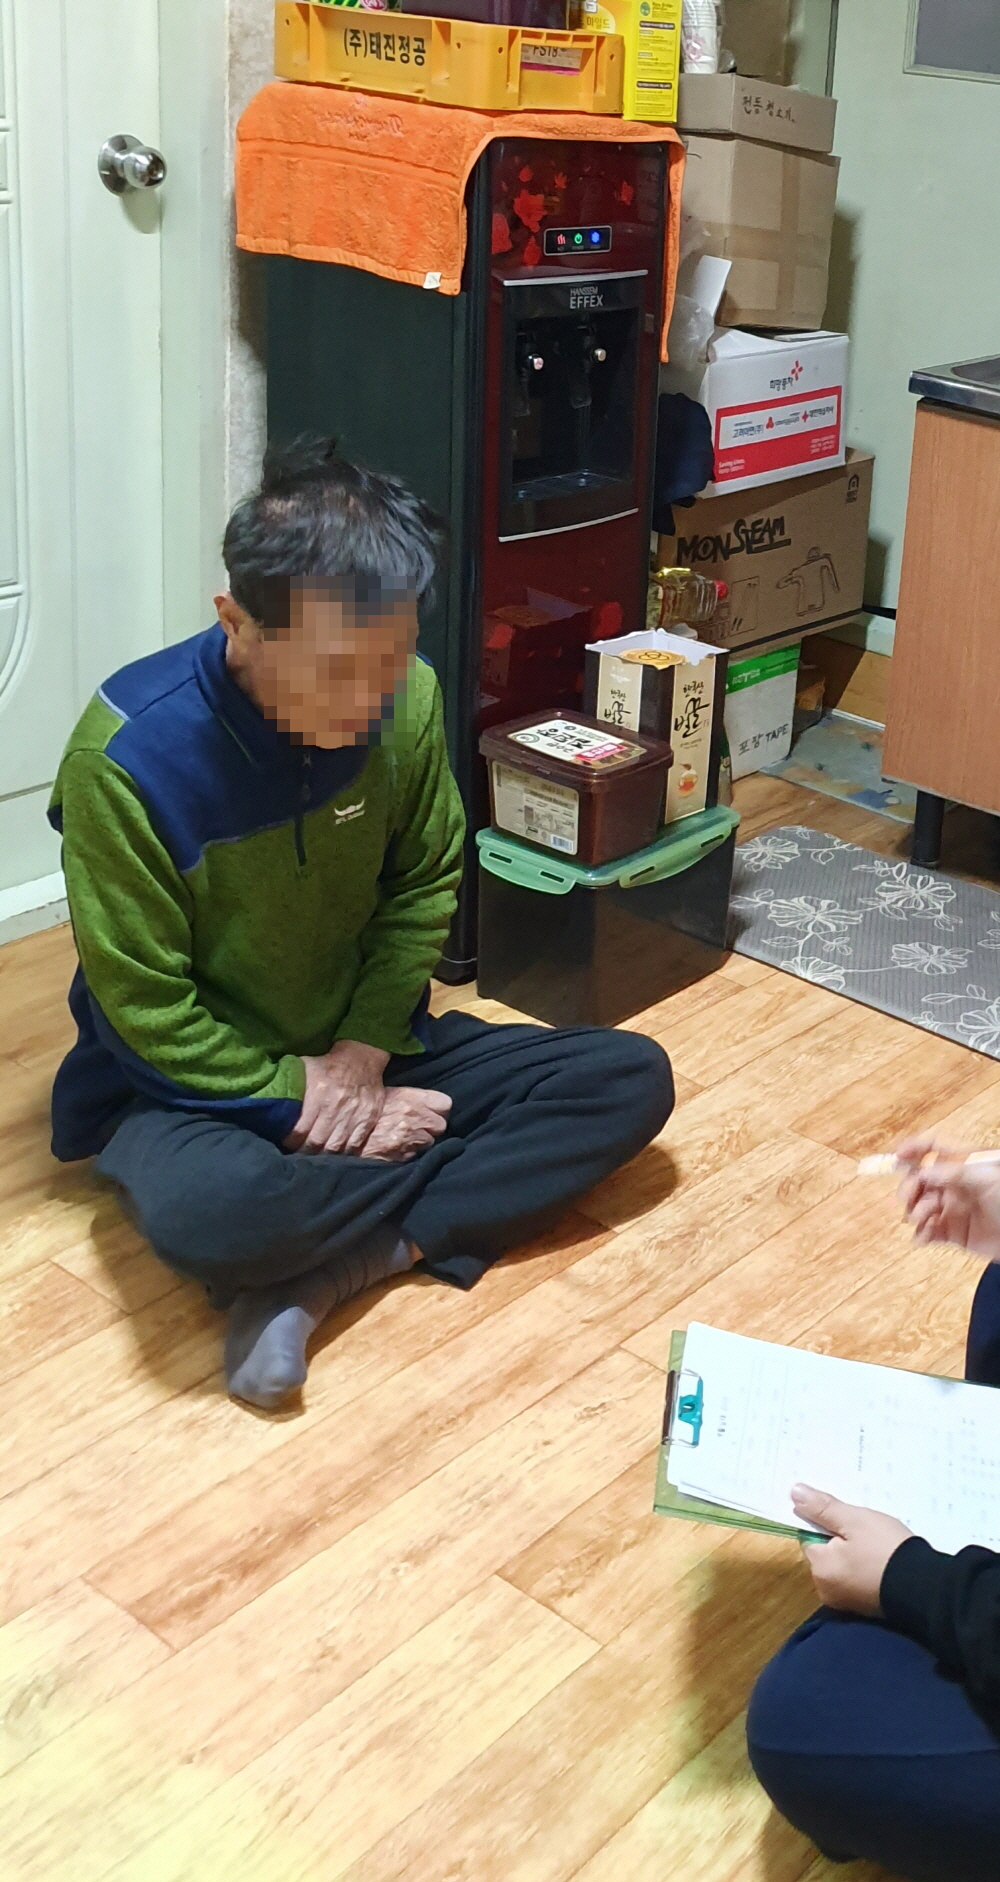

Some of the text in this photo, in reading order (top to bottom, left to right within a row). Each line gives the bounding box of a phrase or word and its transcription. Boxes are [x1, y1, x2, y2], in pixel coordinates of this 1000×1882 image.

[344, 28, 426, 66] (주)태진정공
[743, 94, 763, 115] 전동
[569, 294, 604, 309] EFFEX
[765, 723, 789, 742] TAPE
